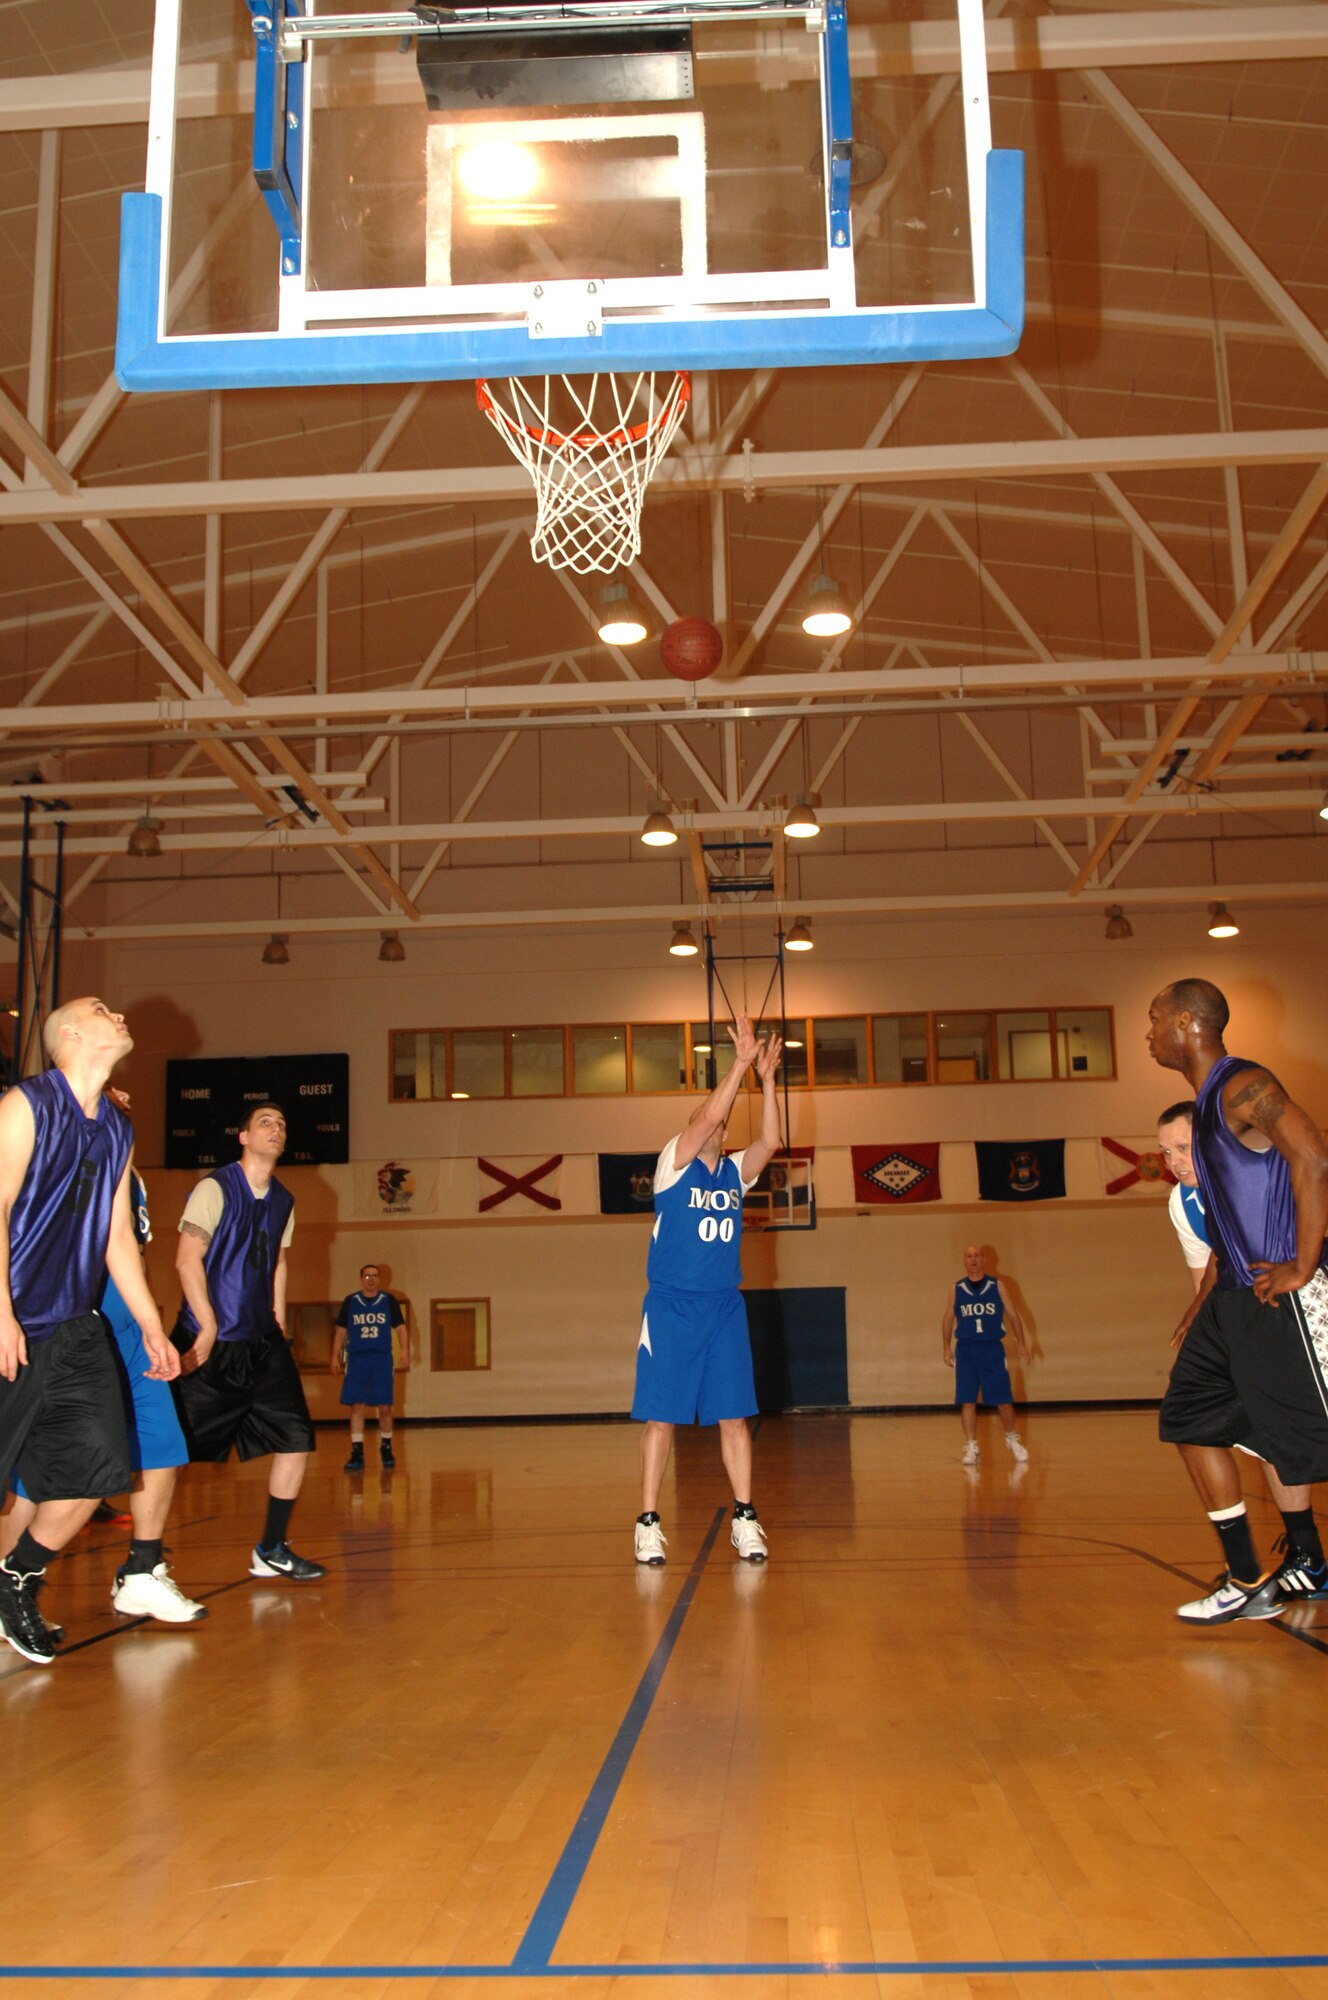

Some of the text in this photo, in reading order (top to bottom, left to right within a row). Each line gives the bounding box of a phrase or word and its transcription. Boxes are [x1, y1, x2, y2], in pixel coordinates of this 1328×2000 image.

[181, 1089, 211, 1099] HOME
[243, 1092, 269, 1100] PERIOD
[299, 1084, 333, 1095] GUEST
[687, 1187, 740, 1211] MOS
[698, 1216, 734, 1242] 00
[960, 1302, 996, 1317] MOS
[353, 1312, 386, 1325] MOS
[361, 1326, 379, 1338] 23
[975, 1318, 984, 1333] 1
